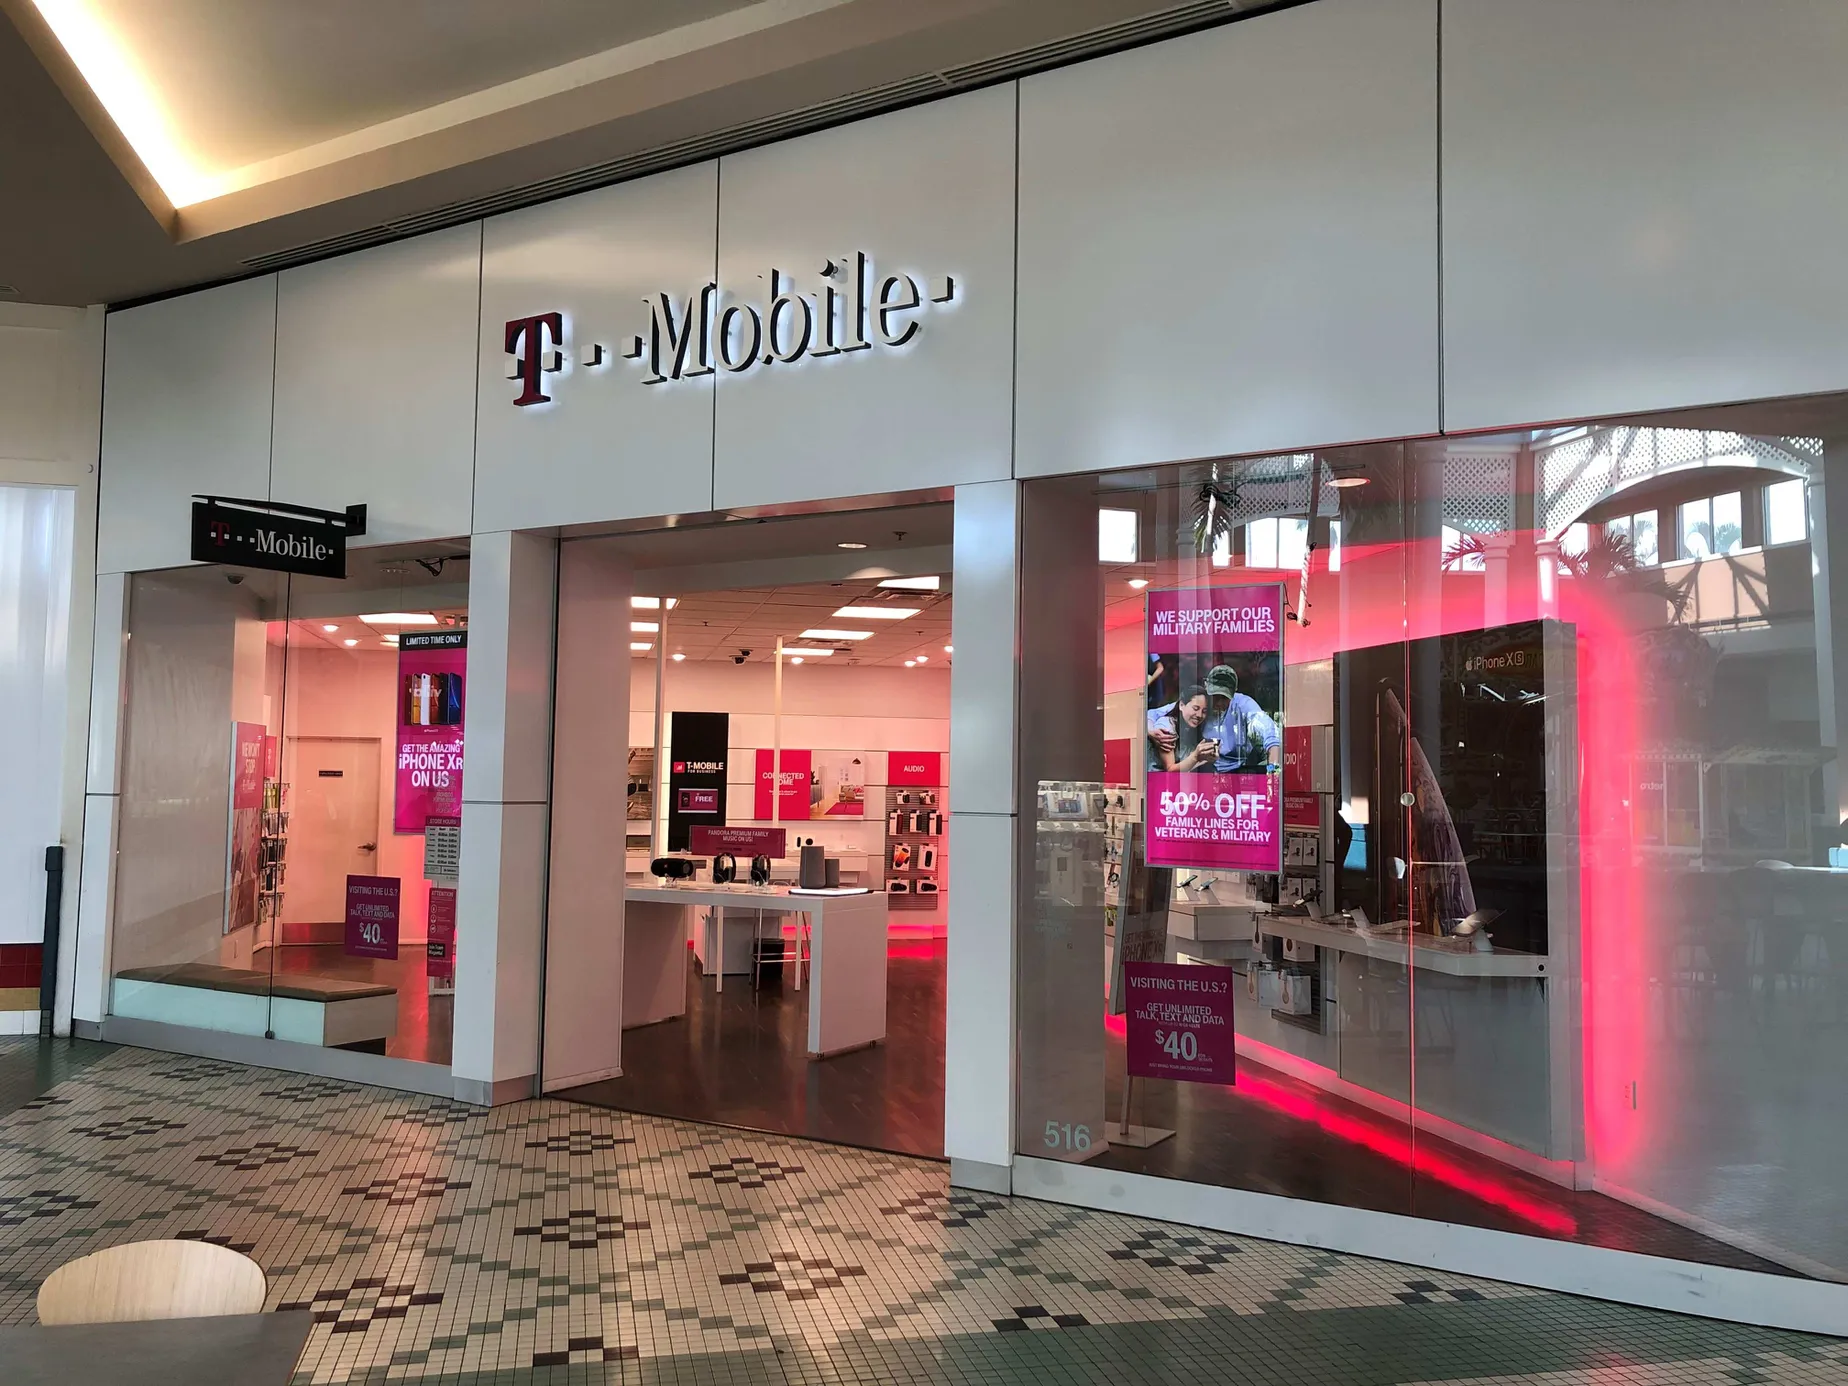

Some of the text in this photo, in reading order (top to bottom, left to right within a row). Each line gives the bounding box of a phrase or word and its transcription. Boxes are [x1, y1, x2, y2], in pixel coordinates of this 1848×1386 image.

[1156, 607, 1271, 623] WE SUPPORT OUR
[1153, 620, 1275, 635] MILITARY FAMILIES
[406, 635, 461, 645] LIMITED TIME ONLY
[1474, 656, 1505, 670] iPhone
[403, 744, 460, 752] GET THE AMAZING
[399, 754, 445, 769] iPHONE
[686, 762, 724, 770] T-MOBILE
[1284, 753, 1296, 765] DIO
[412, 771, 449, 787] ON US
[1160, 792, 1266, 819] 50% OFF
[1166, 817, 1259, 830] FAMILY LINES FOR
[1155, 827, 1271, 842] VETERANS & MILITARY
[349, 886, 398, 896] VISITING THE U.S.?
[359, 922, 380, 944] $40
[1130, 977, 1228, 993] VISITING THE U.S.?
[1147, 1002, 1212, 1015] GET UNLIMITED
[1135, 1010, 1159, 1021] TALK,
[1160, 1012, 1182, 1022] TEXT
[1183, 1014, 1201, 1023] AND
[1203, 1016, 1224, 1025] DATA
[1155, 1029, 1197, 1061] $40
[1044, 1120, 1090, 1151] 516
